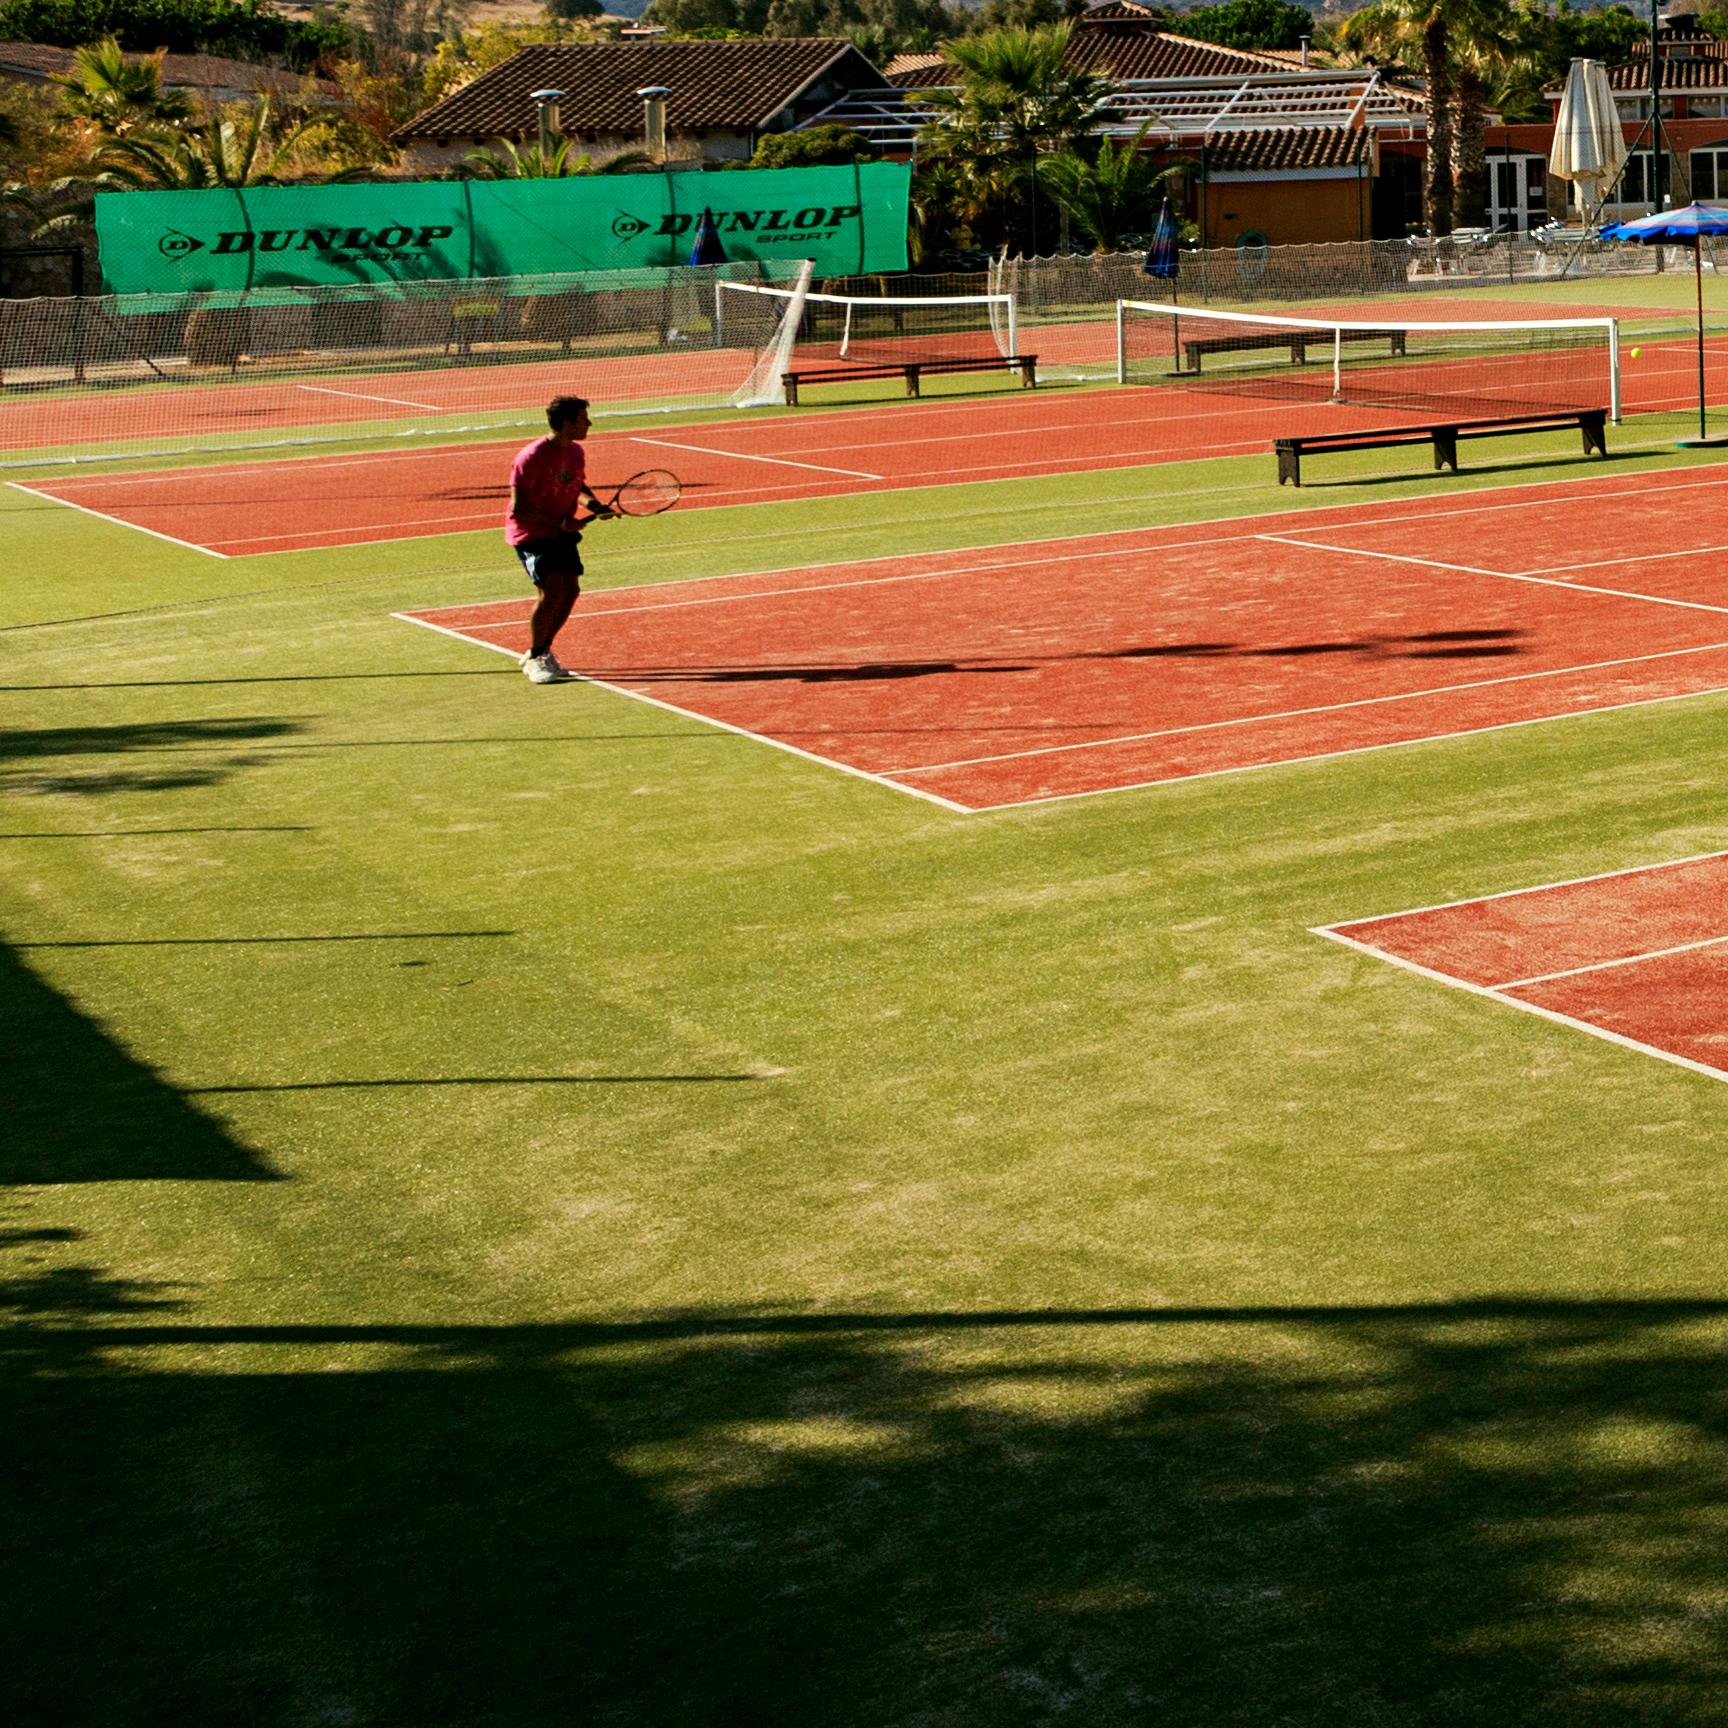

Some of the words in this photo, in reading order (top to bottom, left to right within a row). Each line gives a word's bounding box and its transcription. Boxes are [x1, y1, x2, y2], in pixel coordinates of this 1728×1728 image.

[653, 205, 862, 235] DUNLOP
[209, 225, 454, 254] DUNLOP
[755, 231, 838, 244] SPORT
[331, 252, 429, 264] SPORT
